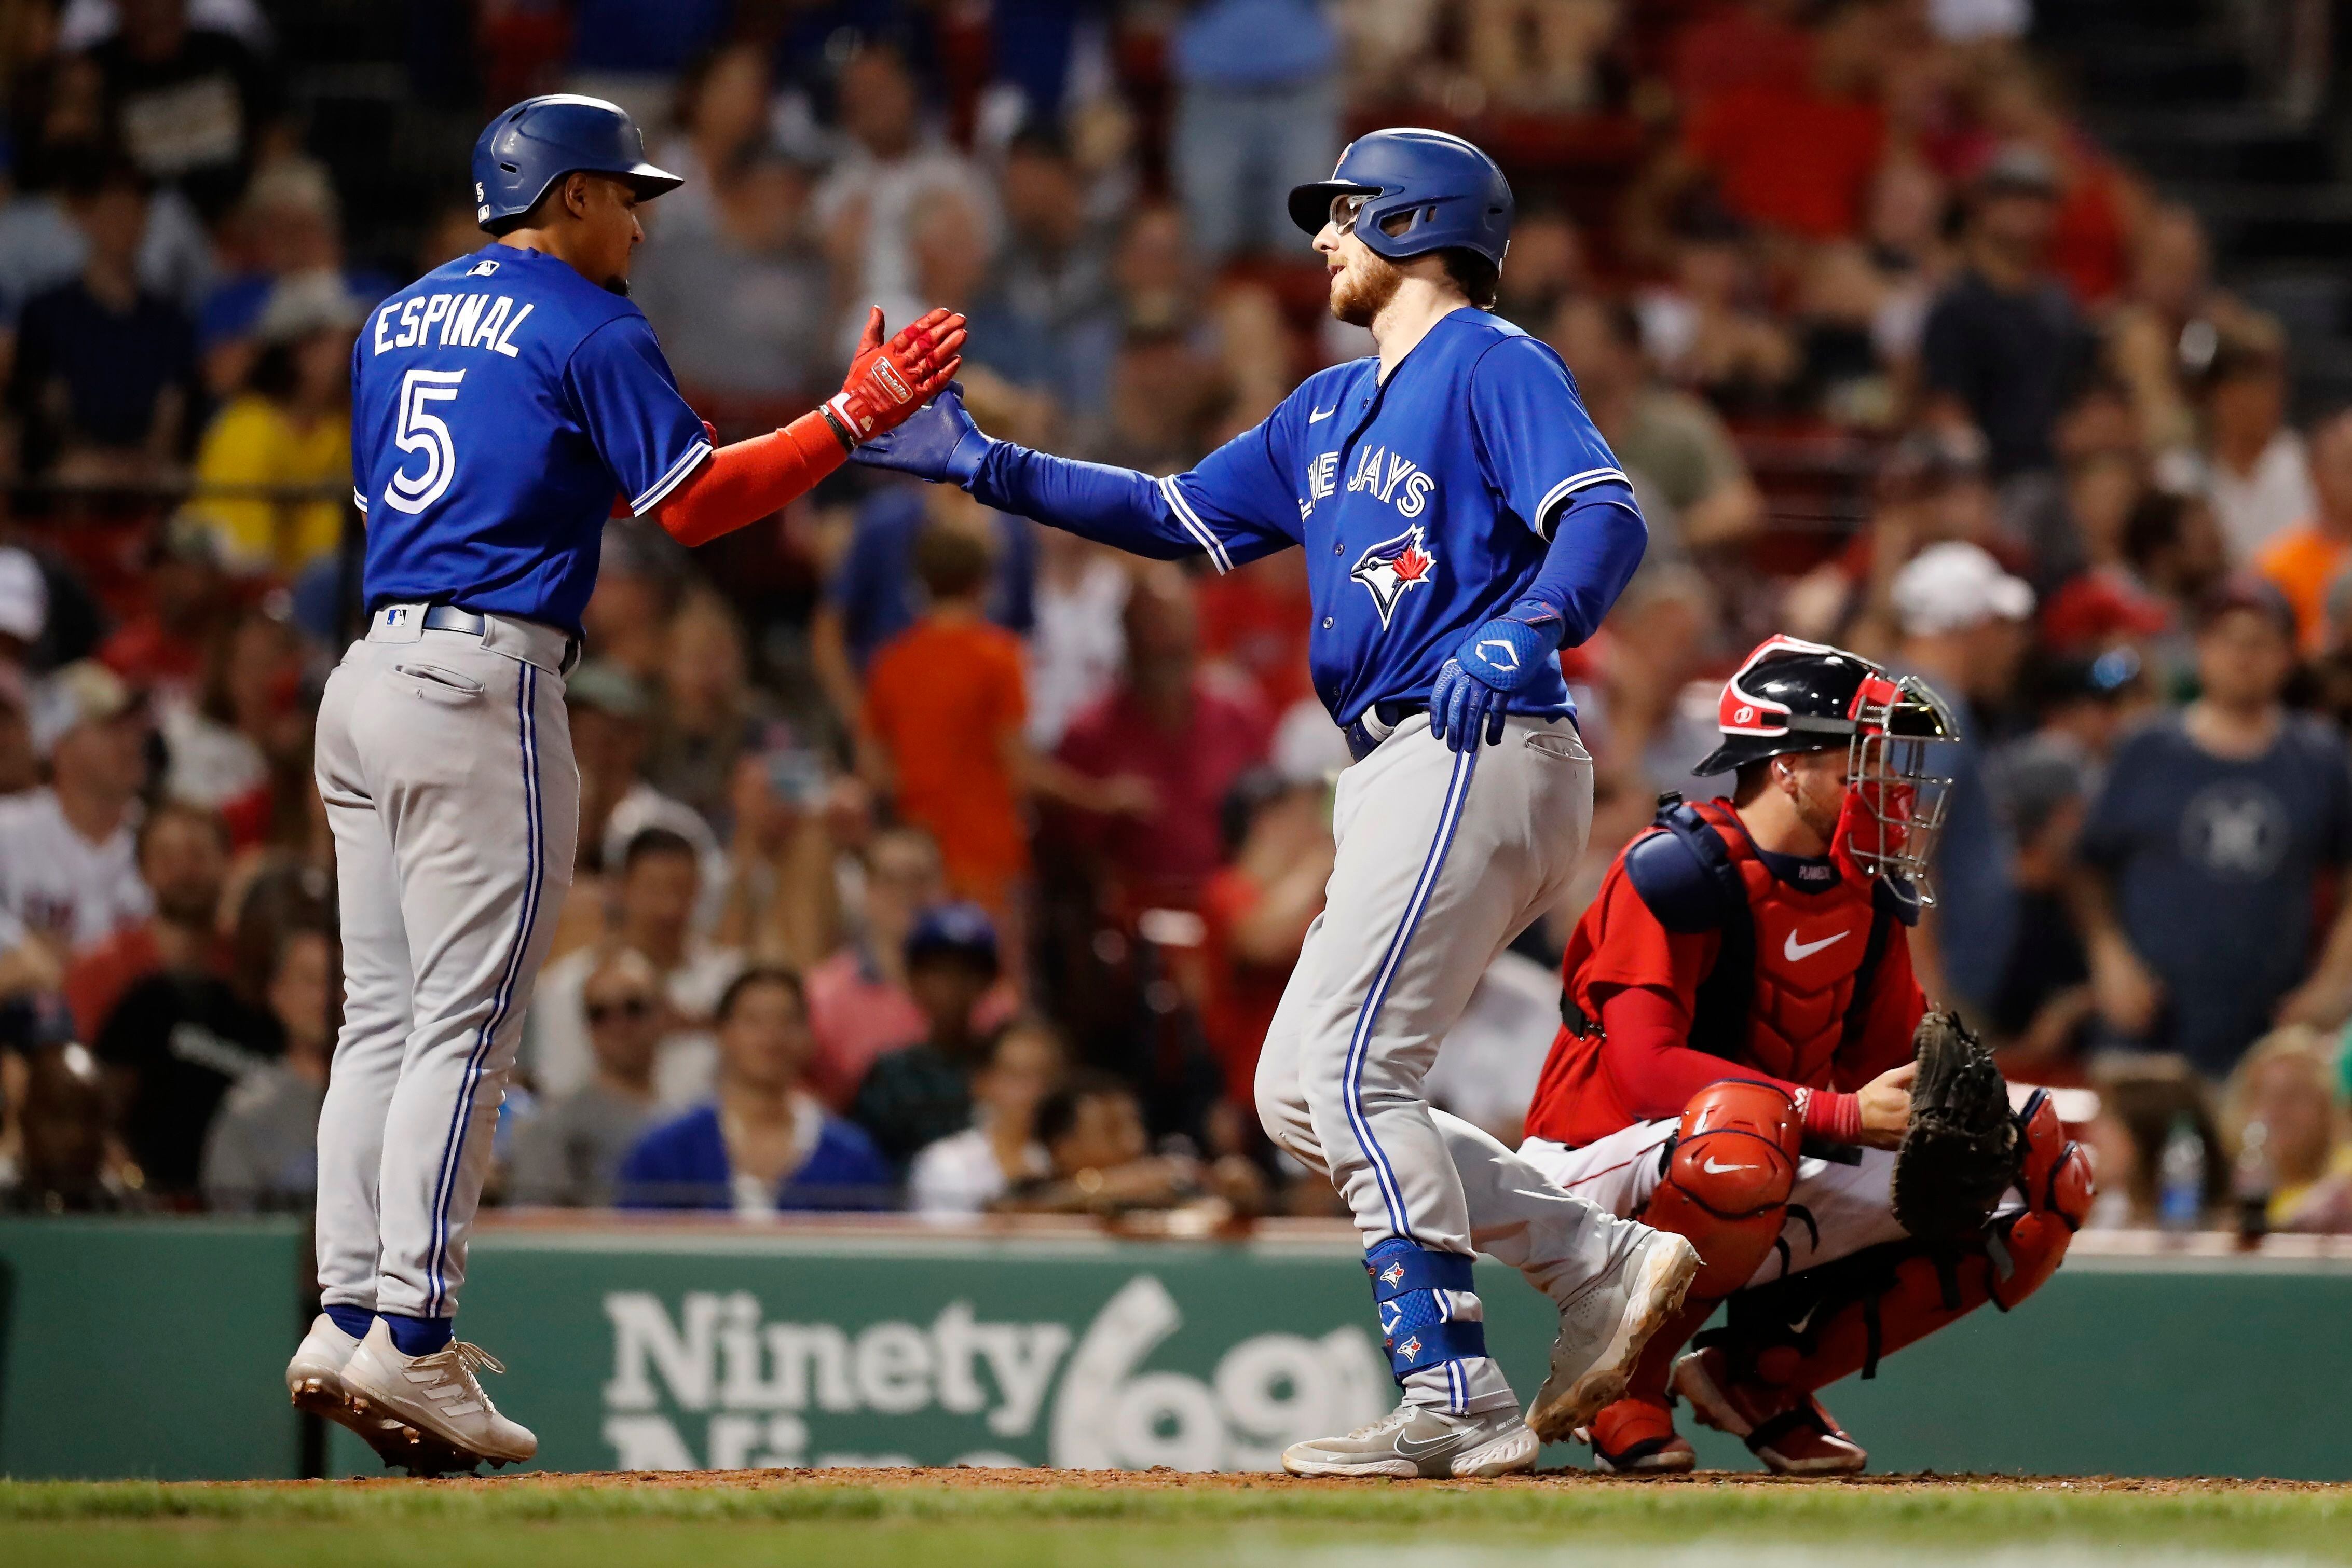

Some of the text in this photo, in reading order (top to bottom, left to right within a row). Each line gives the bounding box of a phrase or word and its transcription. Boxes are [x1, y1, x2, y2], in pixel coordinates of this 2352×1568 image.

[475, 182, 484, 202] 5
[374, 293, 535, 359] ESPINAL
[384, 368, 467, 515] 5
[1347, 444, 1436, 518] JAYS
[603, 1290, 1073, 1437] Ninety
